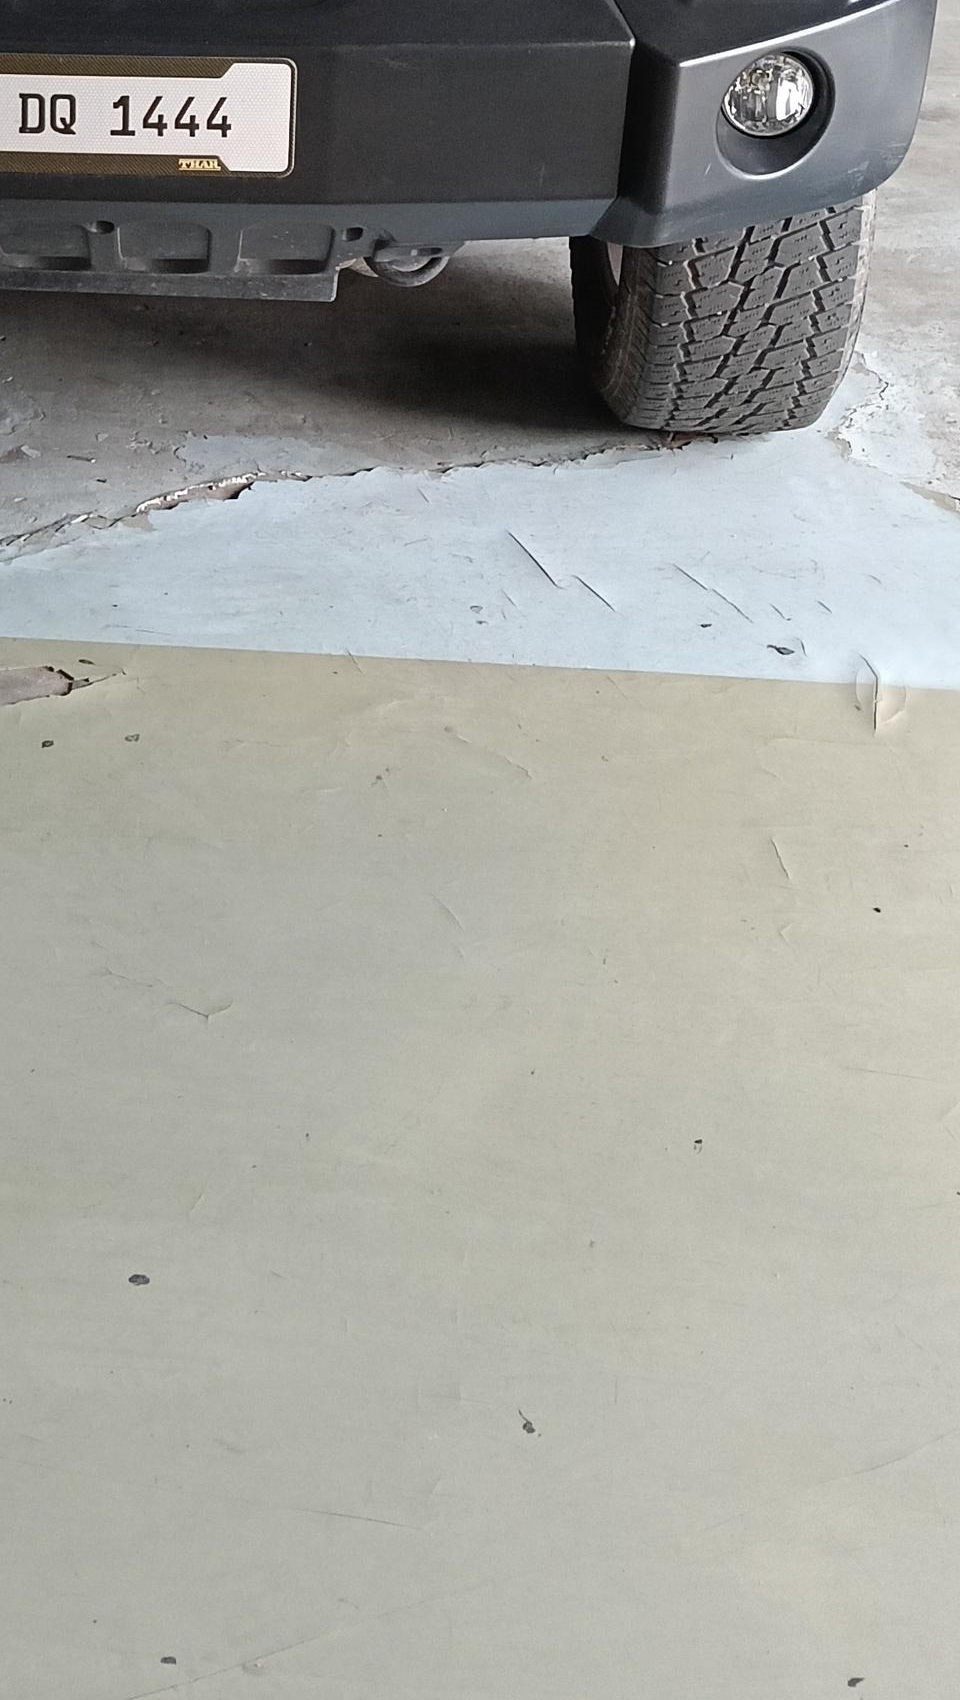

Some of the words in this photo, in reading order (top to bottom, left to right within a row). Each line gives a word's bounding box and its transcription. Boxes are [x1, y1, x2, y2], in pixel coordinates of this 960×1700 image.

[18, 93, 76, 135] DQ
[110, 96, 232, 138] 1444
[178, 158, 221, 171] THAR
